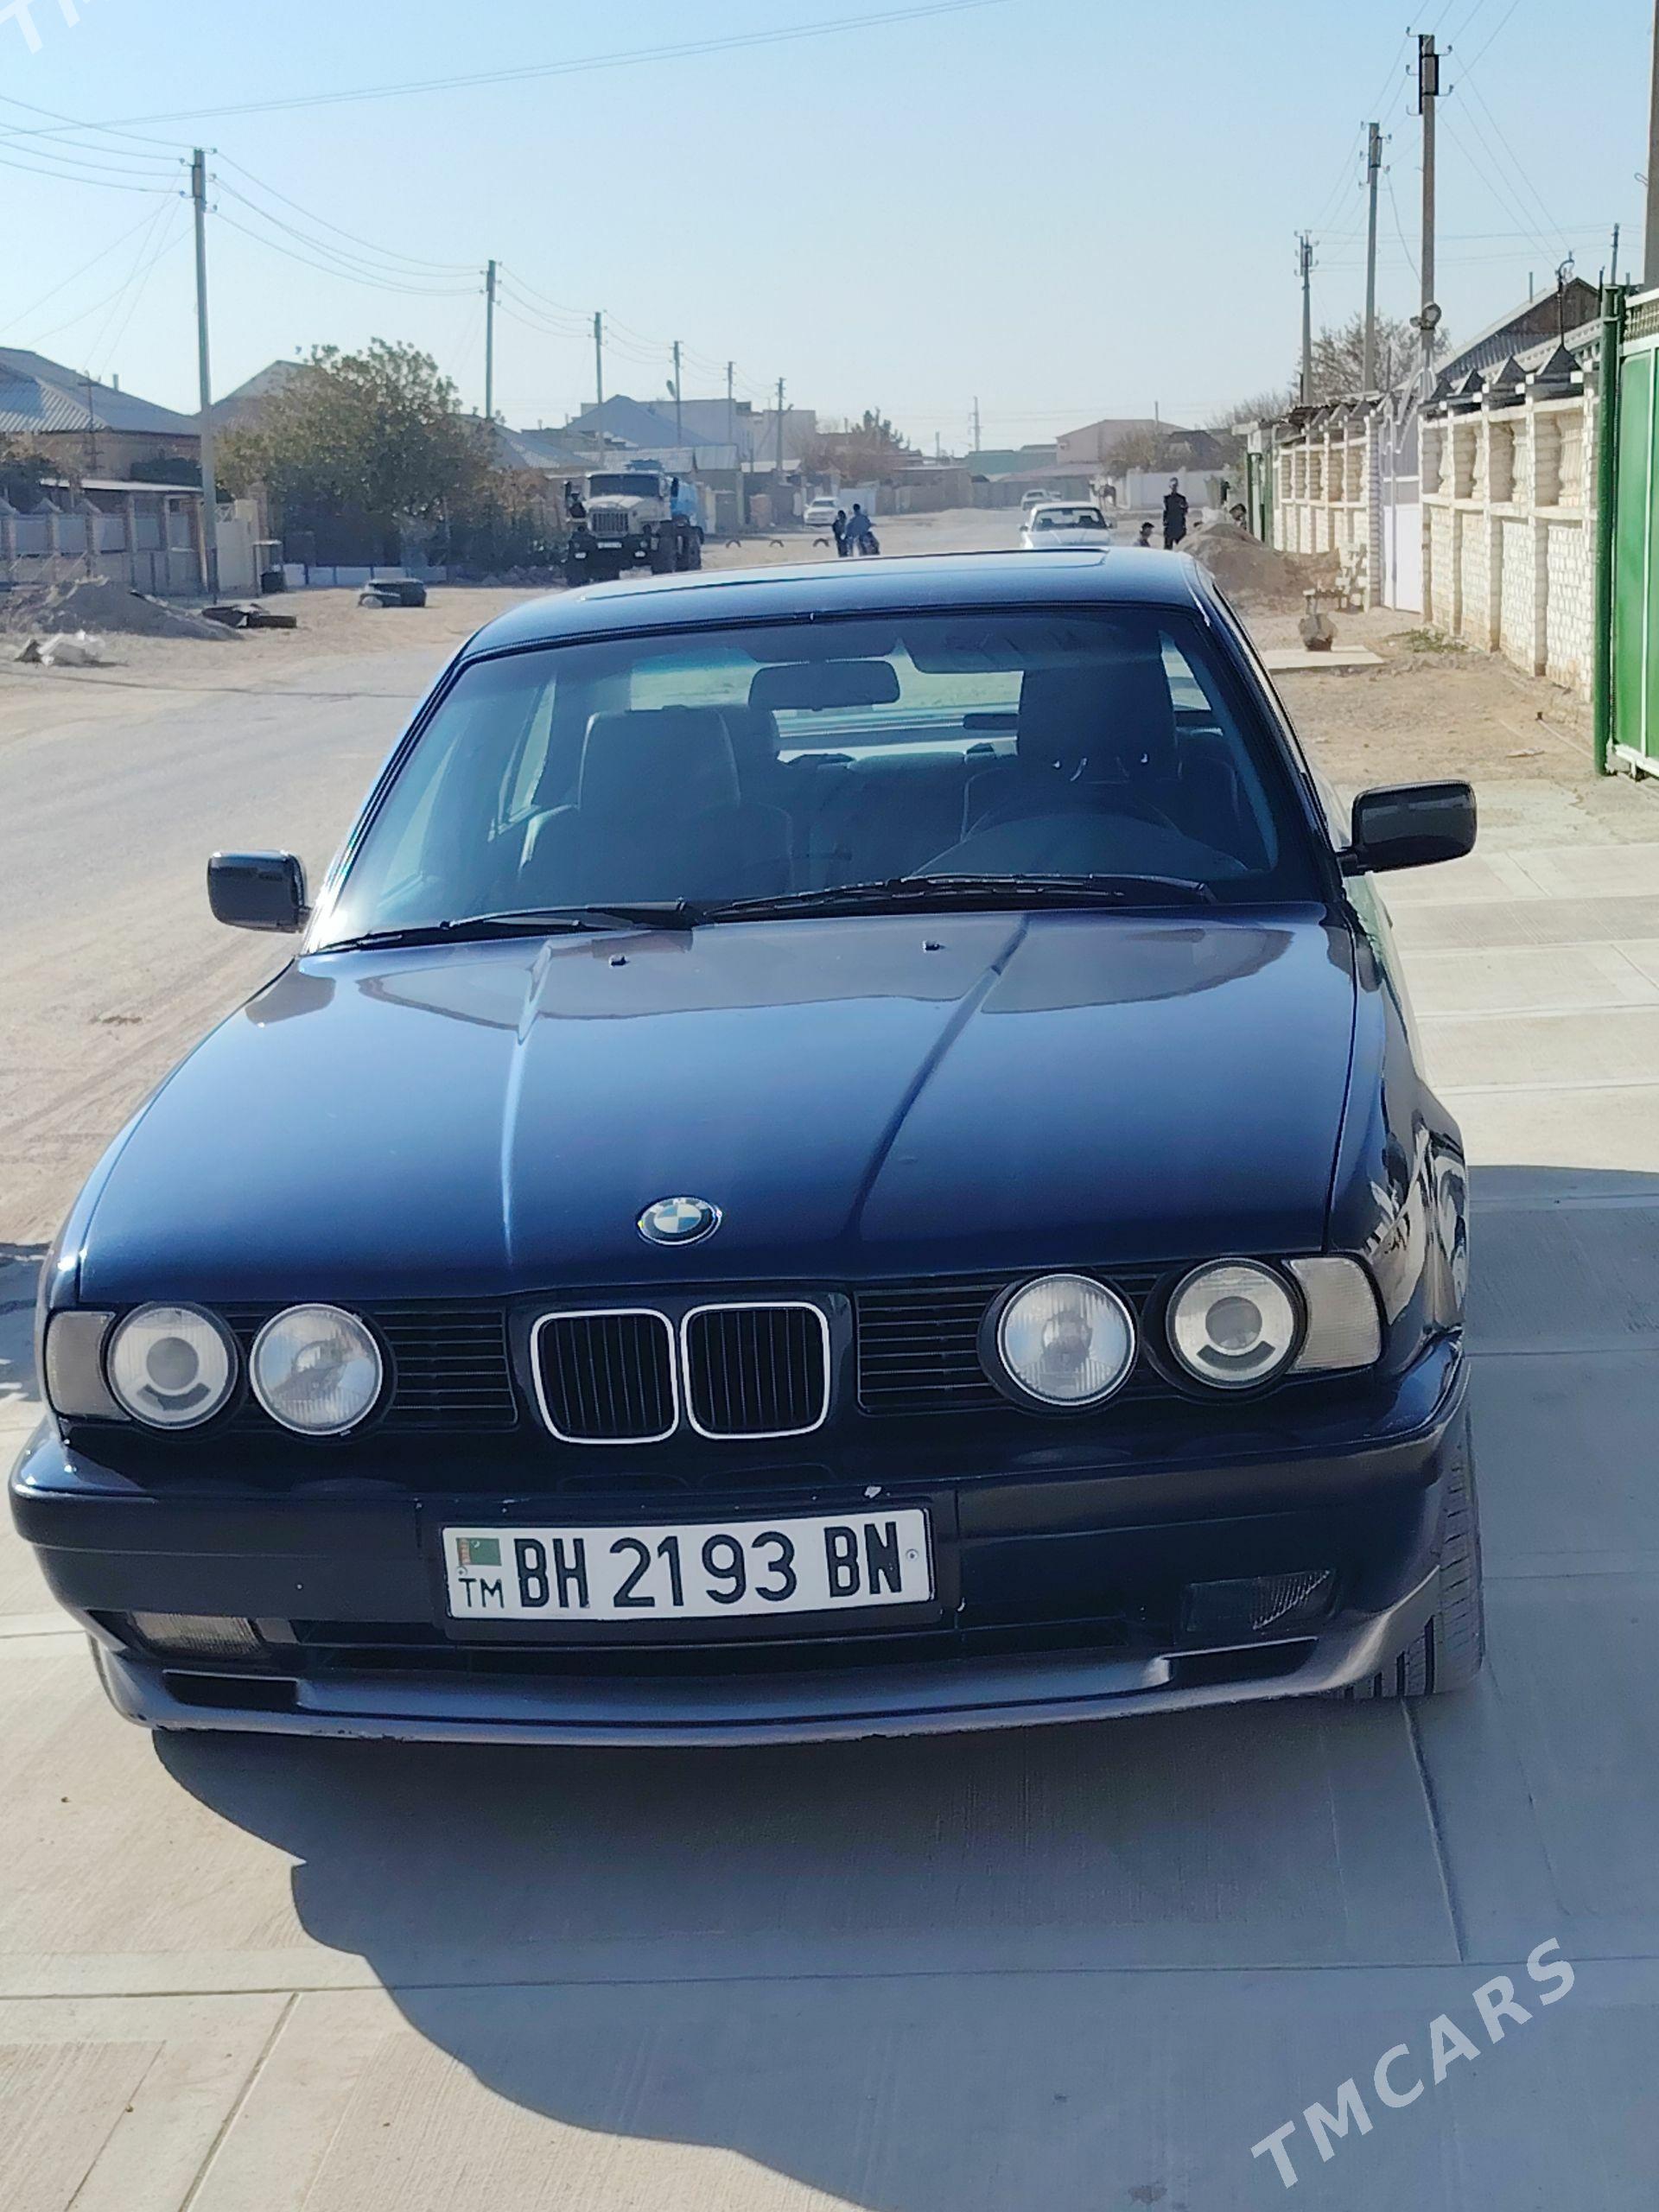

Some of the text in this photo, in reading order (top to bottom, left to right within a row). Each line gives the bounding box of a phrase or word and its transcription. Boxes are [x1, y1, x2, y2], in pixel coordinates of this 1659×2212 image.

[458, 1577, 505, 1609] TM
[513, 1521, 903, 1609] BH 2193 BN
